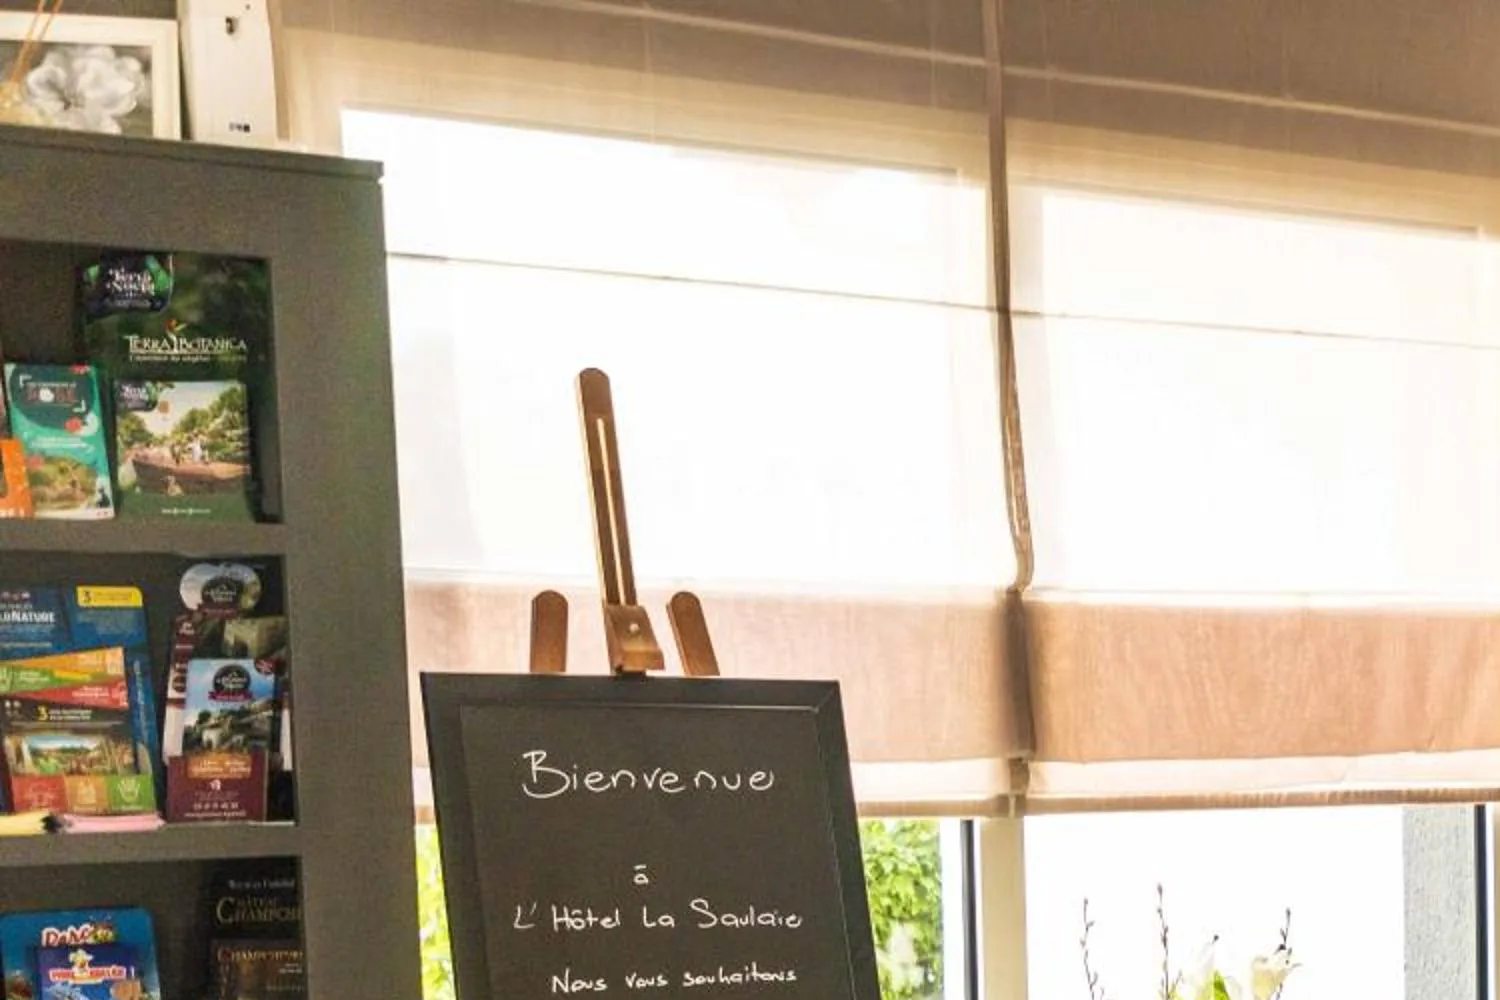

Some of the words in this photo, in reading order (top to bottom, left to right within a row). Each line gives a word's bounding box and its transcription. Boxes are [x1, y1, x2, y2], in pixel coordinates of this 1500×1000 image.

[521, 749, 775, 799] Bienvenue
[642, 905, 676, 929] La
[688, 897, 804, 930] Saulaie
[551, 967, 609, 994] Nous
[682, 961, 798, 988] souhaitons
